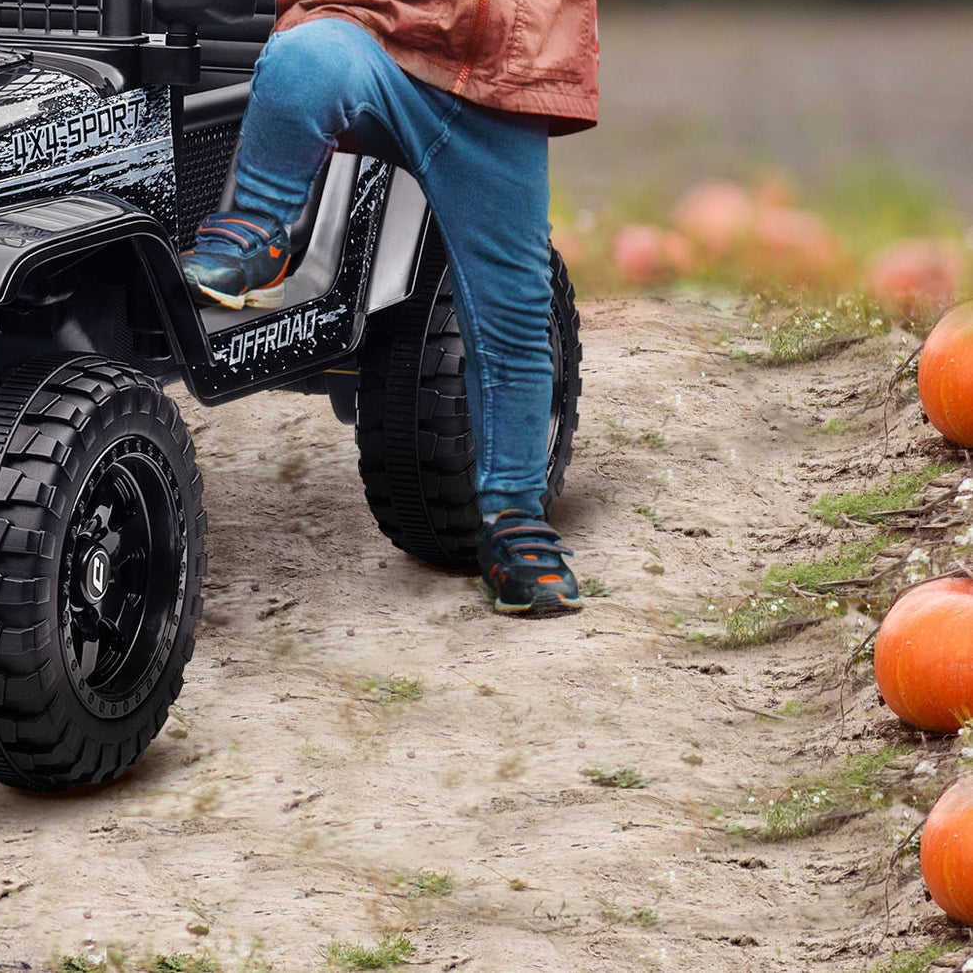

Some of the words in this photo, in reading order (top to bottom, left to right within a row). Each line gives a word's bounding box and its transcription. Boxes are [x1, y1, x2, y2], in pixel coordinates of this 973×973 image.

[13, 125, 58, 167] 4X4
[67, 98, 145, 149] SPORT
[228, 308, 319, 366] OFFROAD
